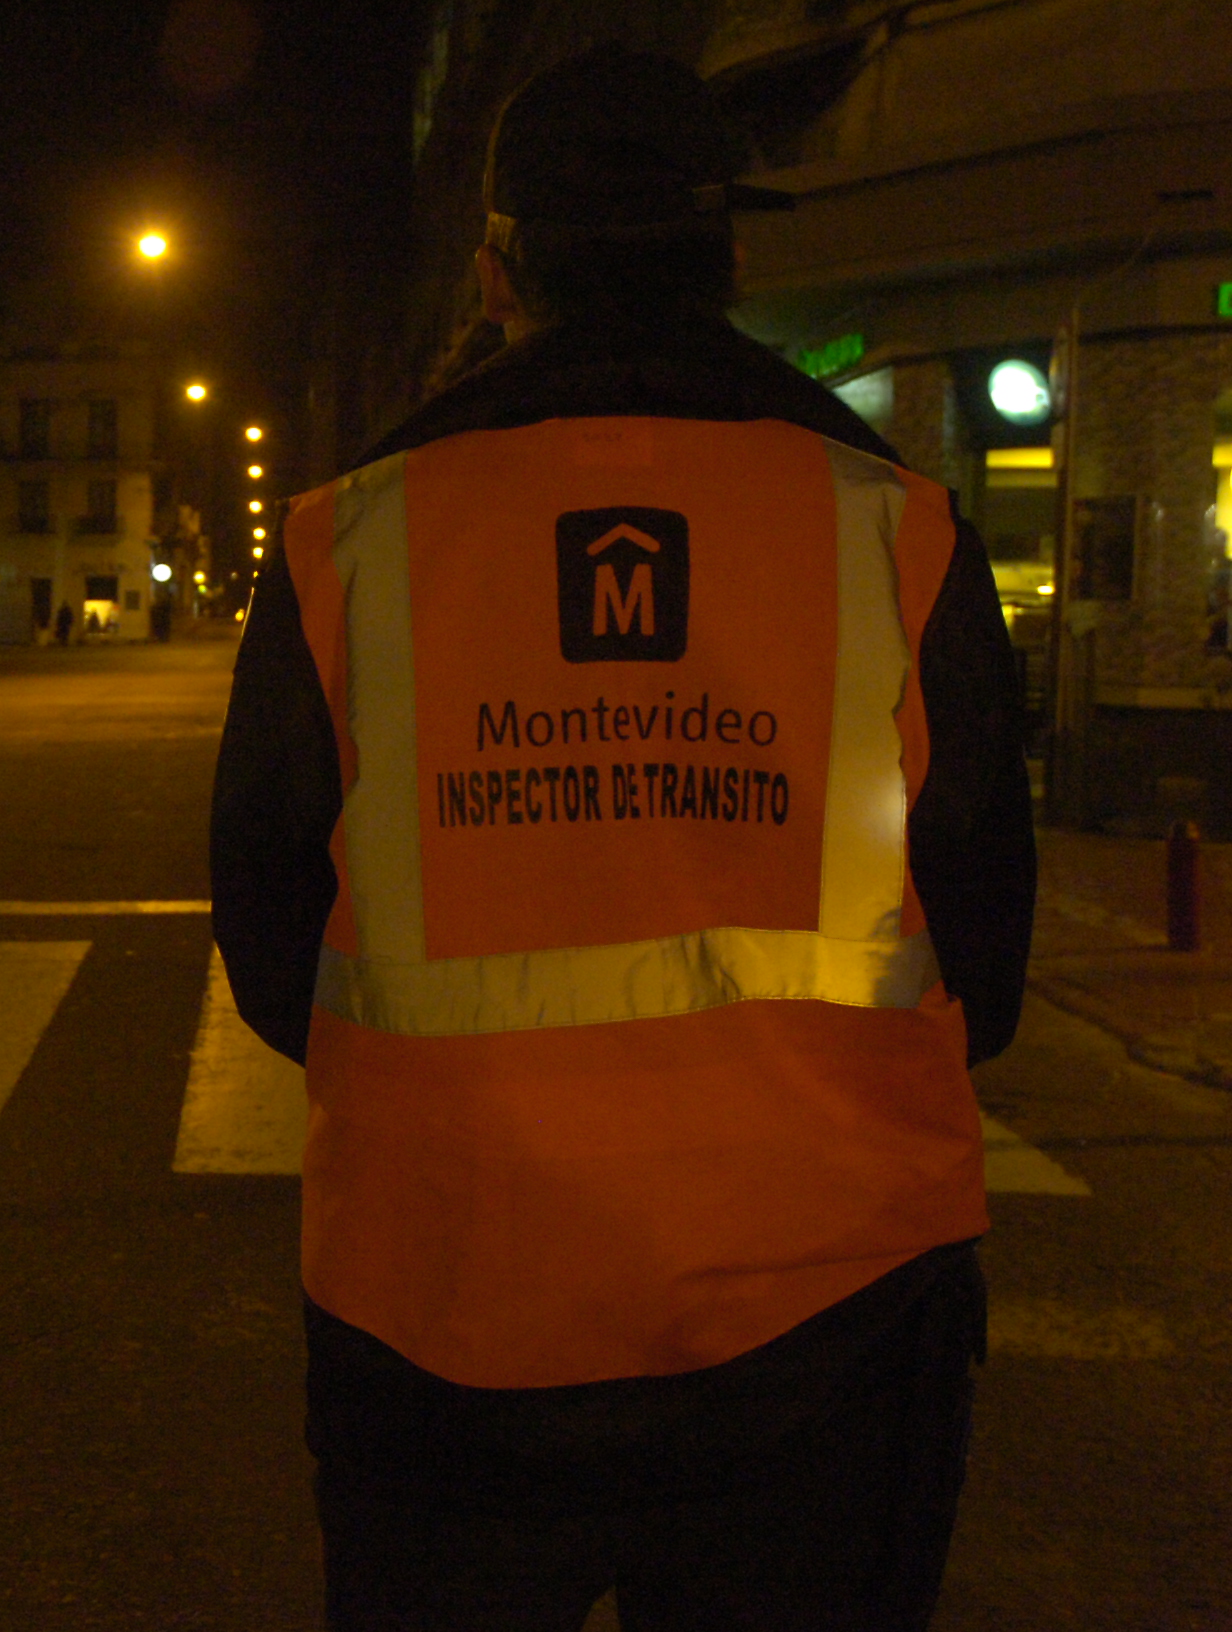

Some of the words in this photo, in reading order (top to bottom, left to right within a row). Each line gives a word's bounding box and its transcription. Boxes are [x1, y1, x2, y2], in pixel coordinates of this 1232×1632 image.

[592, 562, 656, 637] M
[476, 691, 778, 752] Montevideo
[437, 765, 602, 829] INSPECTOR
[612, 763, 641, 821] DE
[642, 763, 789, 827] TRANSITO
